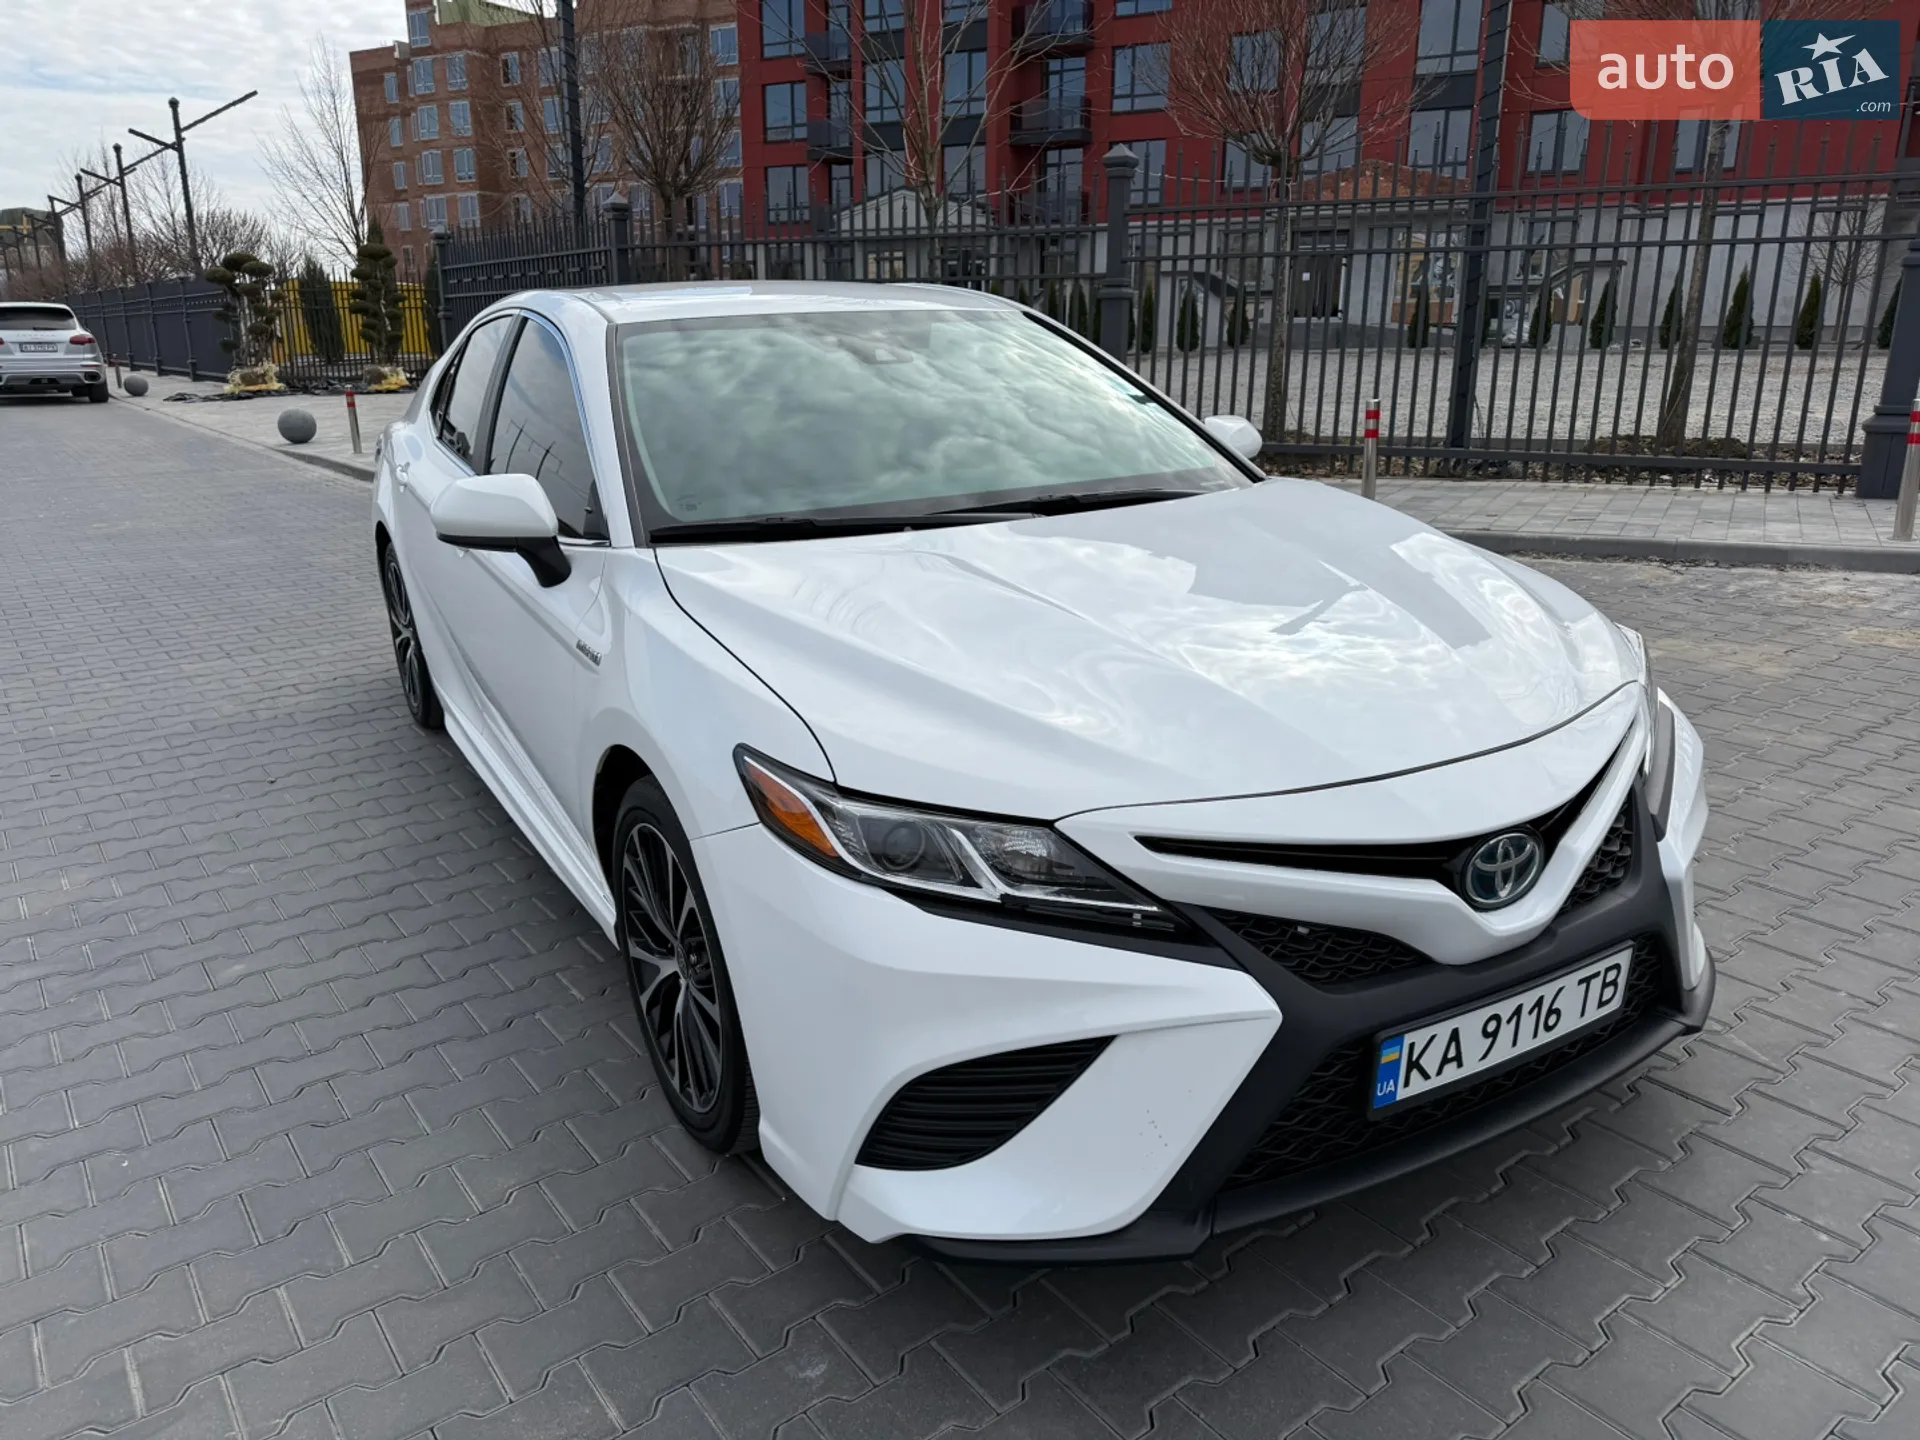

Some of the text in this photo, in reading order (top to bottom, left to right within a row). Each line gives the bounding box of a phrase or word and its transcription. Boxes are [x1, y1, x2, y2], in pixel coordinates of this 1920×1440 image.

[1403, 962, 1622, 1088] KA 9116 TB
[1377, 1079, 1395, 1096] UA
